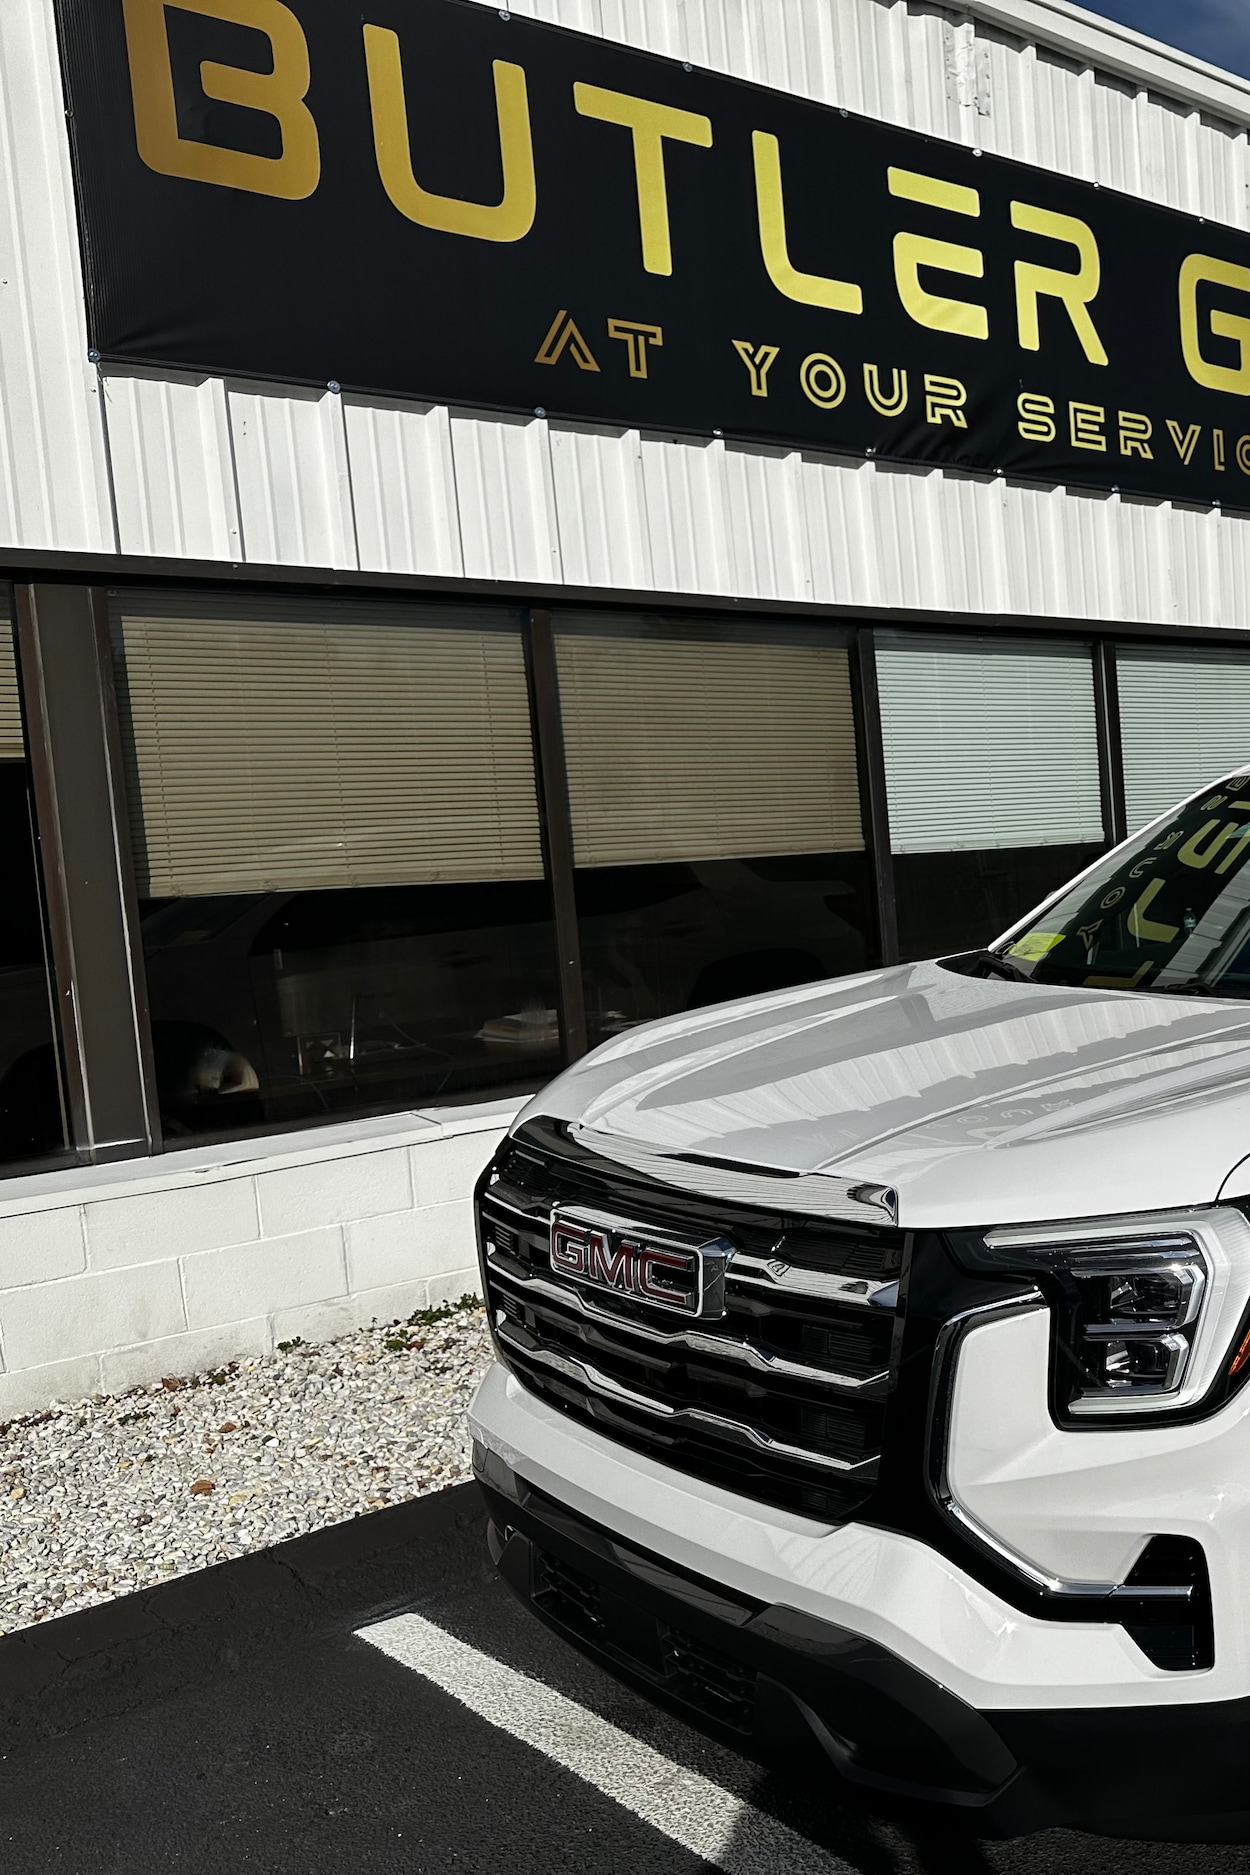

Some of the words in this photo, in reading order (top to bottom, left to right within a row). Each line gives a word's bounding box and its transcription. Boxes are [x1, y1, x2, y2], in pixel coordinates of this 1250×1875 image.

[122, 0, 1108, 366] BUTLER
[535, 309, 664, 380] AT
[731, 339, 968, 429] YOUR
[550, 1219, 696, 1308] GMC
